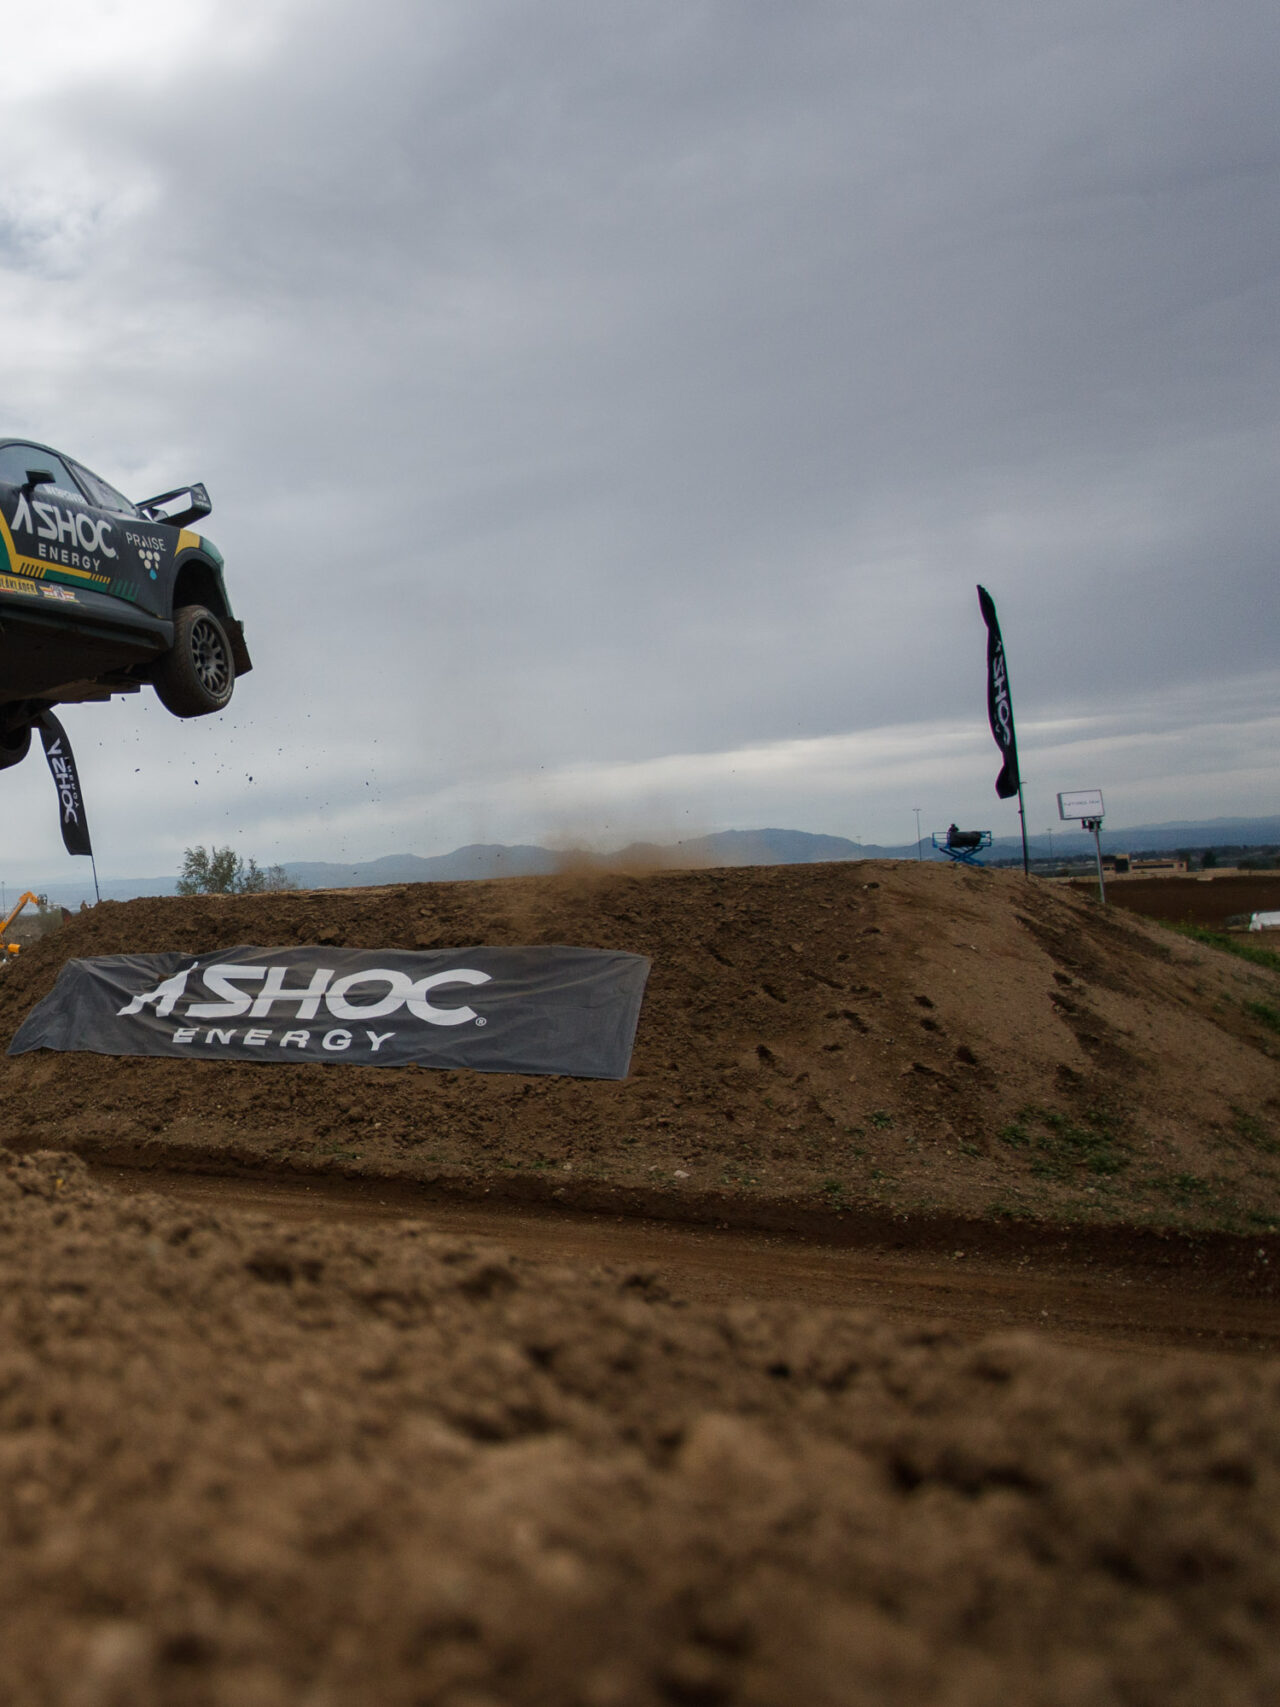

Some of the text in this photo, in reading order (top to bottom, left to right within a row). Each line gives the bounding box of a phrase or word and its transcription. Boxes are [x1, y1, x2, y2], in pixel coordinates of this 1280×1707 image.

[11, 492, 116, 558] ASHOC
[125, 531, 167, 552] PRAISE
[38, 542, 101, 572] ENERGY
[993, 636, 1011, 746] ASHOC
[117, 960, 492, 1027] ASHOC
[172, 1027, 396, 1053] ENERGY
